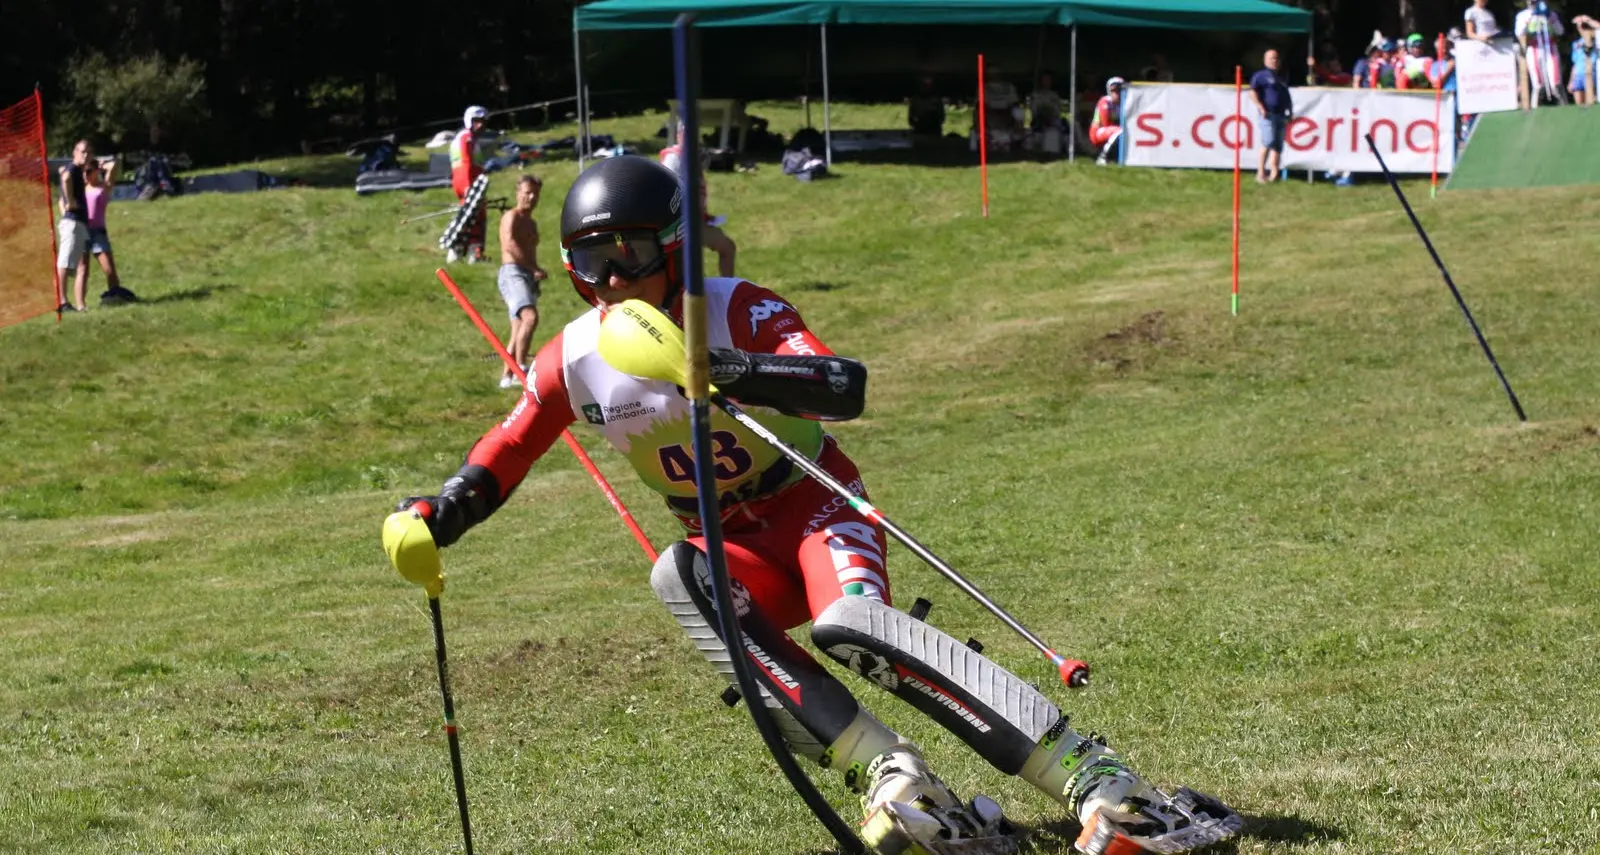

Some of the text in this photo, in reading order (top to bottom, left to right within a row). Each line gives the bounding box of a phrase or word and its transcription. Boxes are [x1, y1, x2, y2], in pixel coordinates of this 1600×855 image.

[622, 307, 664, 345] GABEL
[603, 401, 642, 414] Regione
[606, 406, 656, 422] Lombardia
[903, 675, 992, 734] ENERGIAPURA
